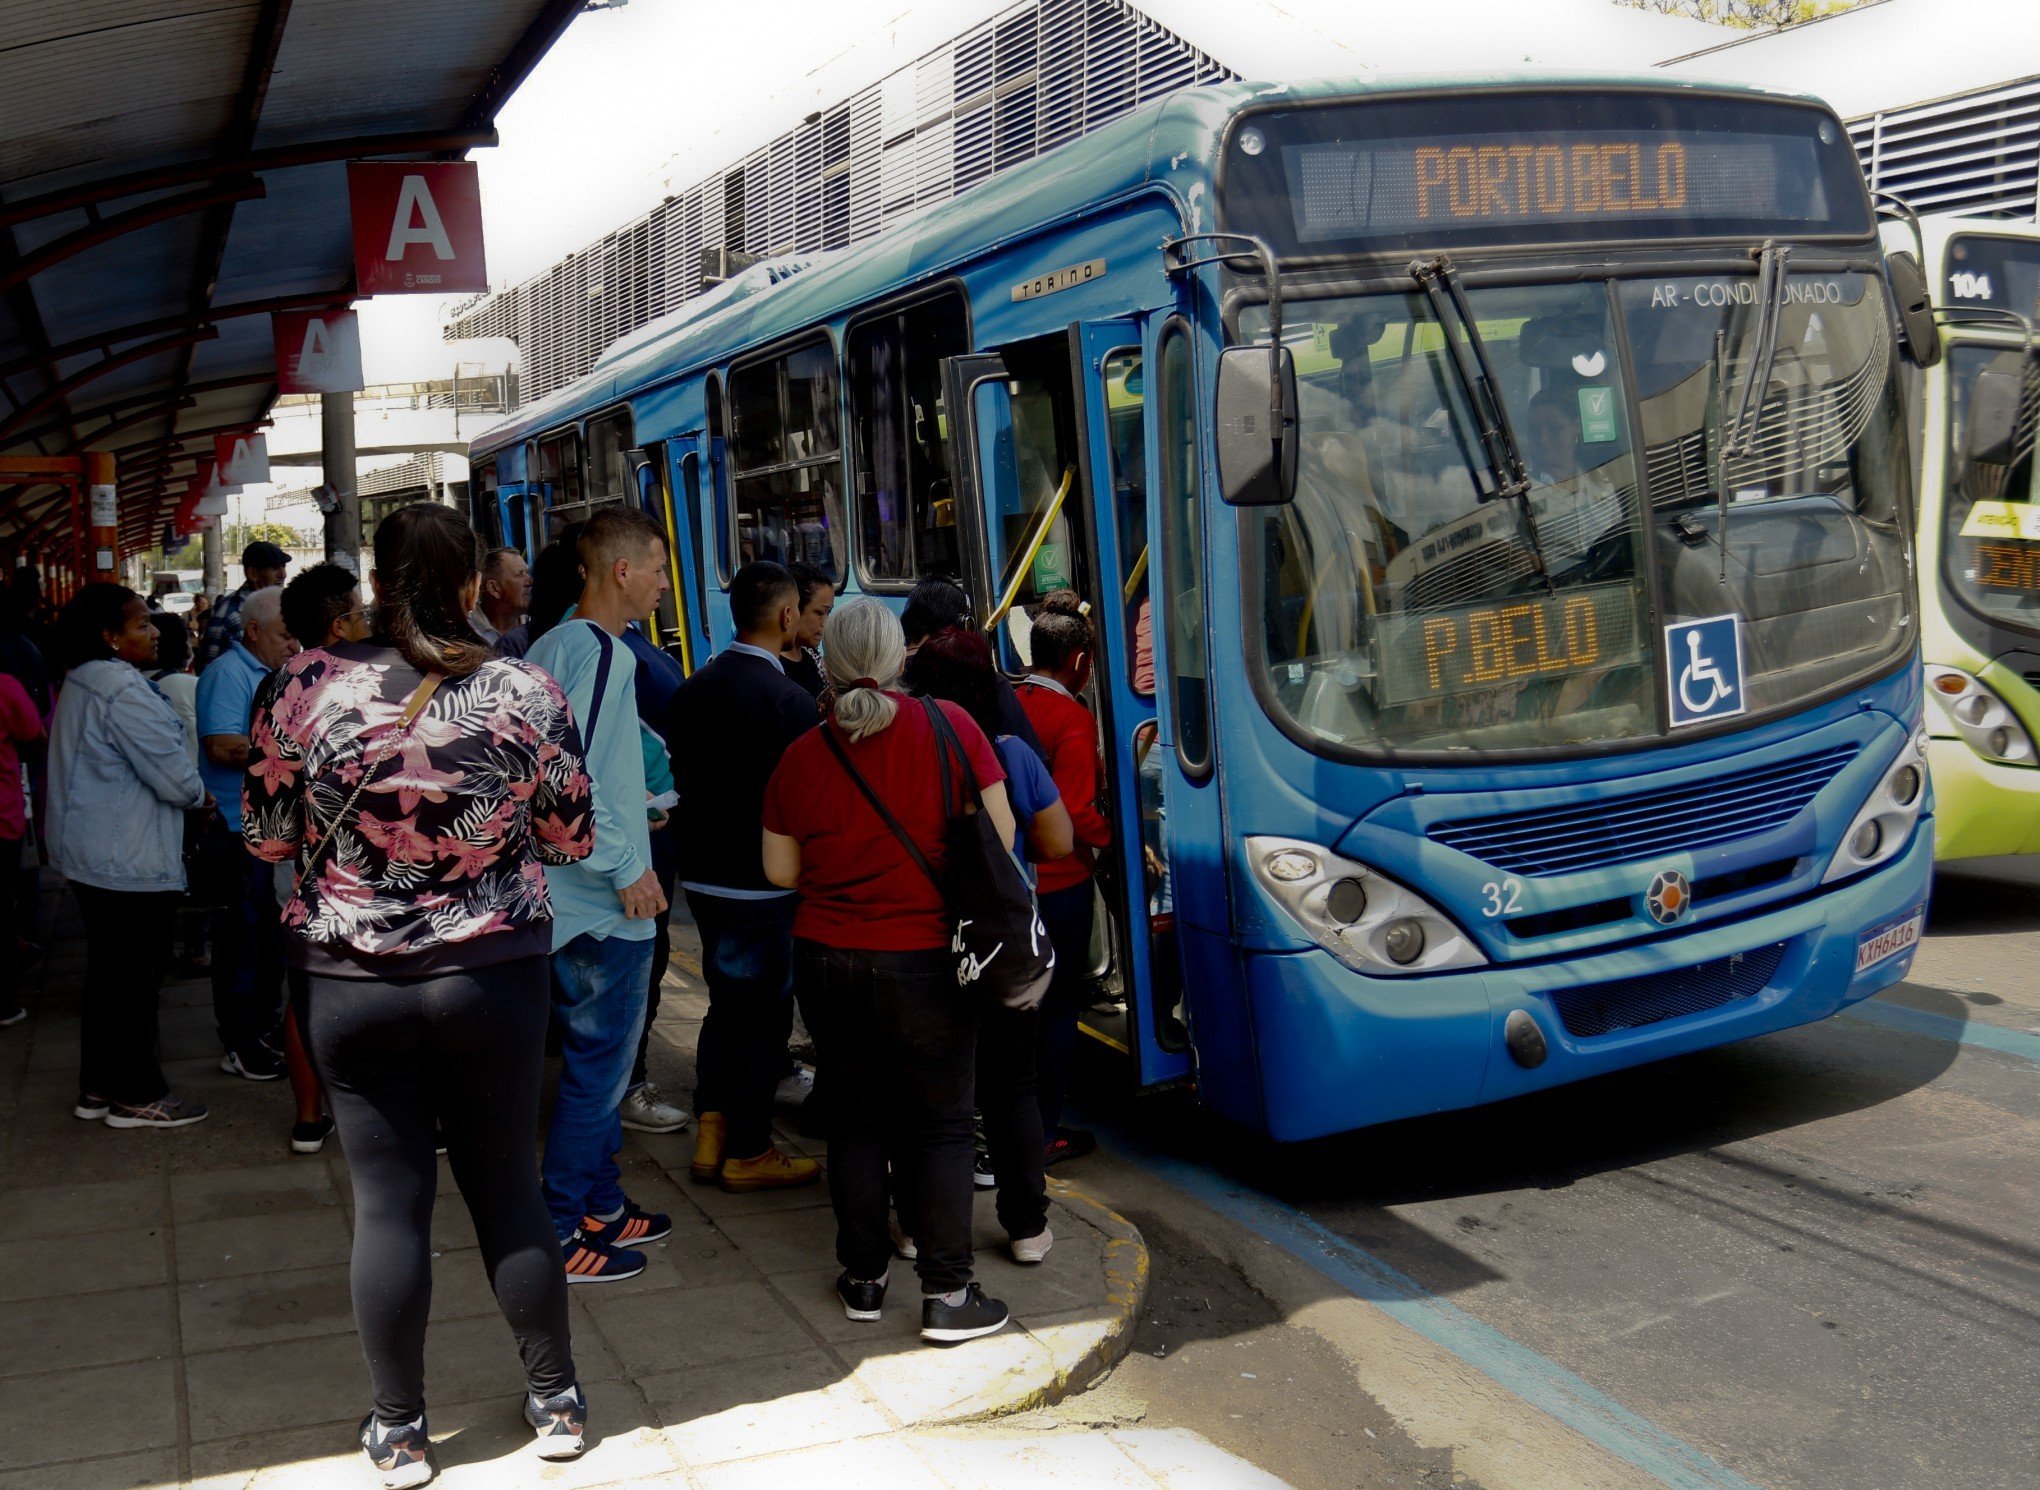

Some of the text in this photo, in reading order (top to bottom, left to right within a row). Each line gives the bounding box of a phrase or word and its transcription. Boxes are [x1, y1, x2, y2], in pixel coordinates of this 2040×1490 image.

[1416, 143, 1686, 217] PORTO BELO
[385, 175, 456, 261] A
[1023, 265, 1091, 297] TORINO
[1651, 285, 1677, 307] AR
[1694, 282, 1840, 307] CONDINADO
[1949, 273, 1991, 299] 104
[297, 318, 336, 376] A
[1424, 598, 1599, 689] P.BELO
[1482, 878, 1522, 917] 32
[1858, 922, 1913, 967] KXH6A16
